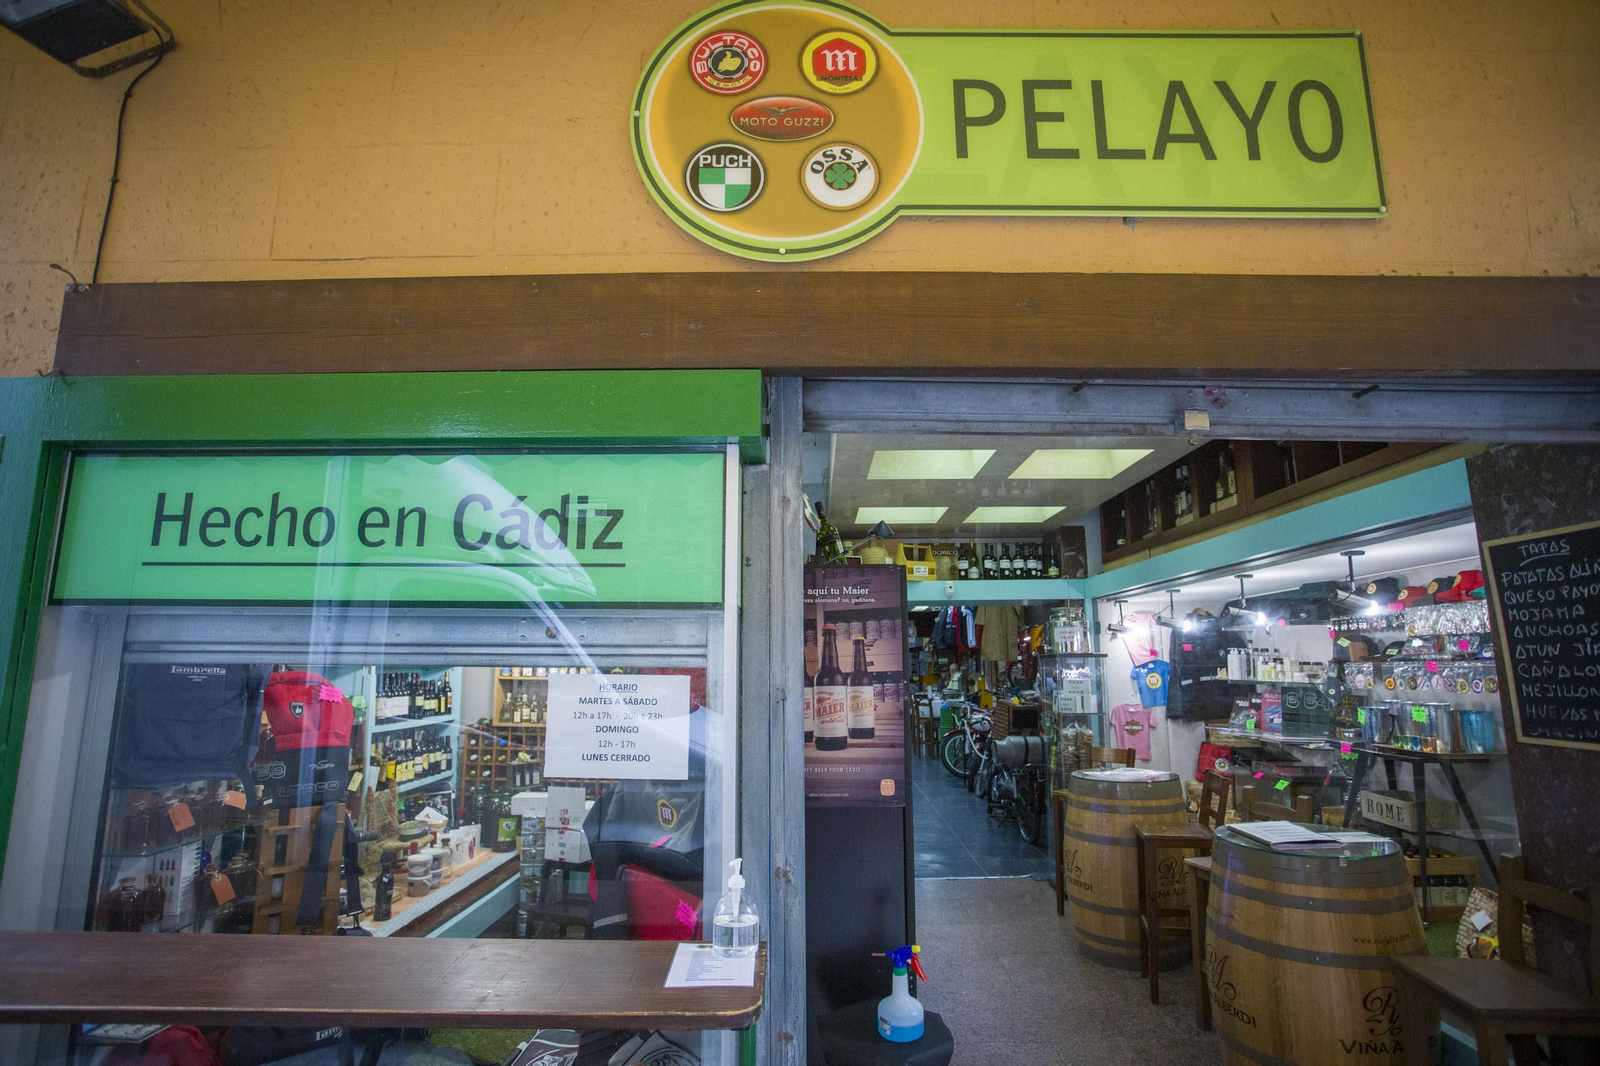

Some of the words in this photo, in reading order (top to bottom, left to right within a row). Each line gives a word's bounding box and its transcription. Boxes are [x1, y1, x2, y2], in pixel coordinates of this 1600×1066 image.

[696, 36, 761, 74] BULTACO
[740, 117, 778, 127] MOTO
[783, 117, 825, 127] GUZZI
[952, 78, 1345, 164] PELAYO
[699, 154, 752, 168] PUCH
[810, 147, 868, 175] OSSA
[150, 491, 336, 549] Hecho
[356, 507, 426, 549] en
[452, 491, 626, 550] Cádiz
[1517, 539, 1570, 557] TAPAS
[1501, 566, 1565, 587] PATATAS
[807, 586, 828, 597] aquí
[830, 587, 840, 595] tu
[842, 586, 869, 595] Maier
[1504, 589, 1555, 605] QUESO
[1559, 583, 1600, 599] PAYO
[1508, 604, 1585, 621] MOJAMA
[1514, 622, 1599, 639] ANCHOAS
[1516, 643, 1561, 659] ATUN
[599, 683, 638, 692] HORARIO
[578, 697, 613, 706] MARTES
[615, 698, 621, 706] A
[622, 696, 658, 706] SÁBADO
[573, 711, 588, 720] 12h
[597, 712, 612, 720] 17h
[623, 712, 639, 720] 20h
[1526, 704, 1587, 721] HUEVAS
[595, 725, 639, 734] DOMINGO
[598, 740, 613, 748] 12h
[620, 740, 636, 748] 17h
[582, 753, 609, 762] LUNES
[610, 753, 651, 763] CERRADO
[1366, 798, 1404, 822] HOME
[1338, 1038, 1389, 1055] VIÑA
